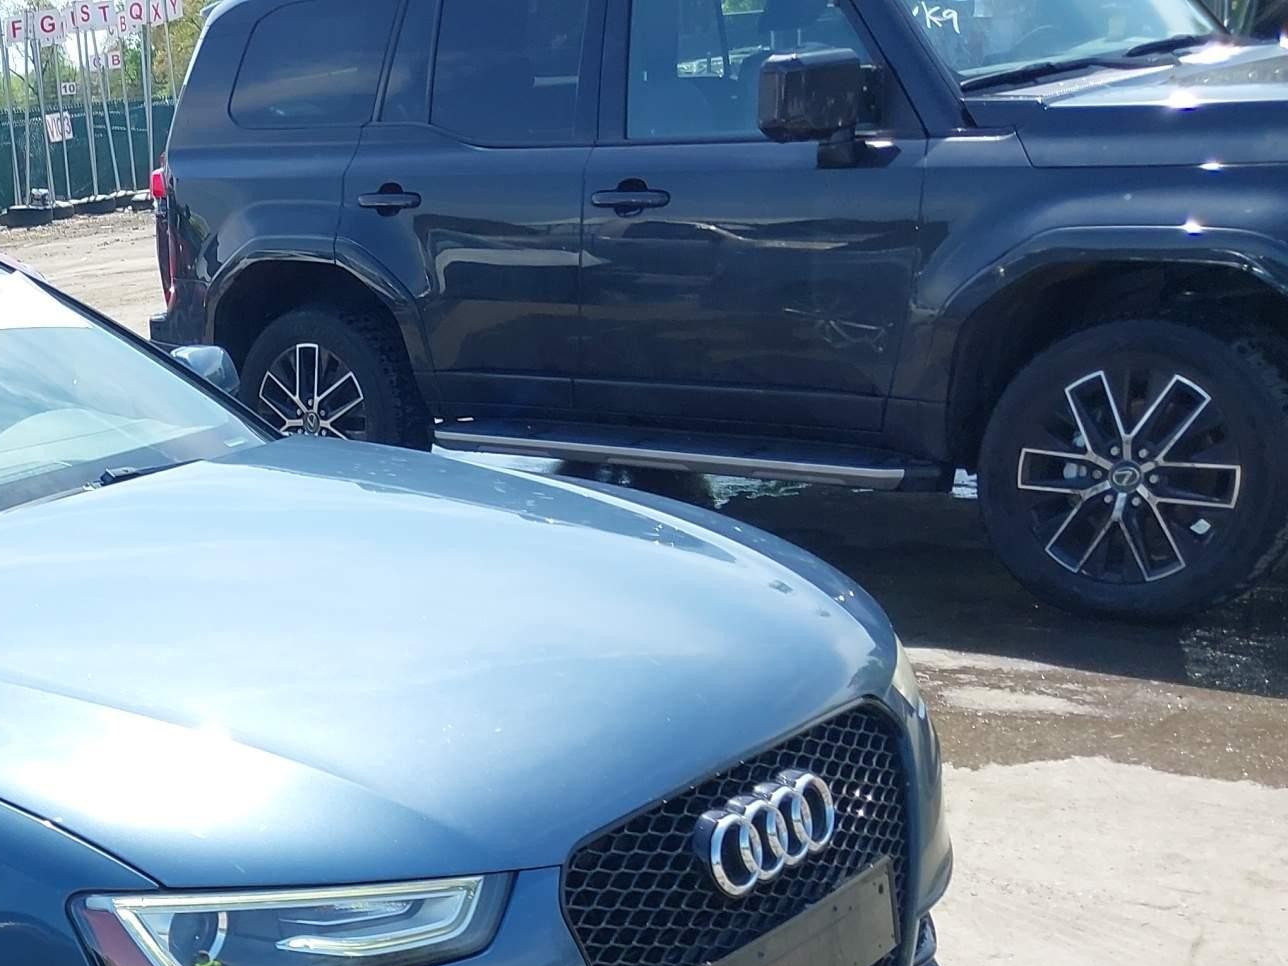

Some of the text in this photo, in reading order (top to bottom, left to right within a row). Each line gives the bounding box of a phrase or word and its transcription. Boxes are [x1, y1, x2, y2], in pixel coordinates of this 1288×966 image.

[80, 4, 90, 22] S
[98, 5, 109, 22] T
[129, 2, 143, 20] Q
[152, 3, 161, 21] X
[12, 20, 22, 38] F
[40, 15, 56, 33] G
[119, 15, 127, 32] B
[112, 54, 120, 66] B
[62, 84, 75, 94] 10
